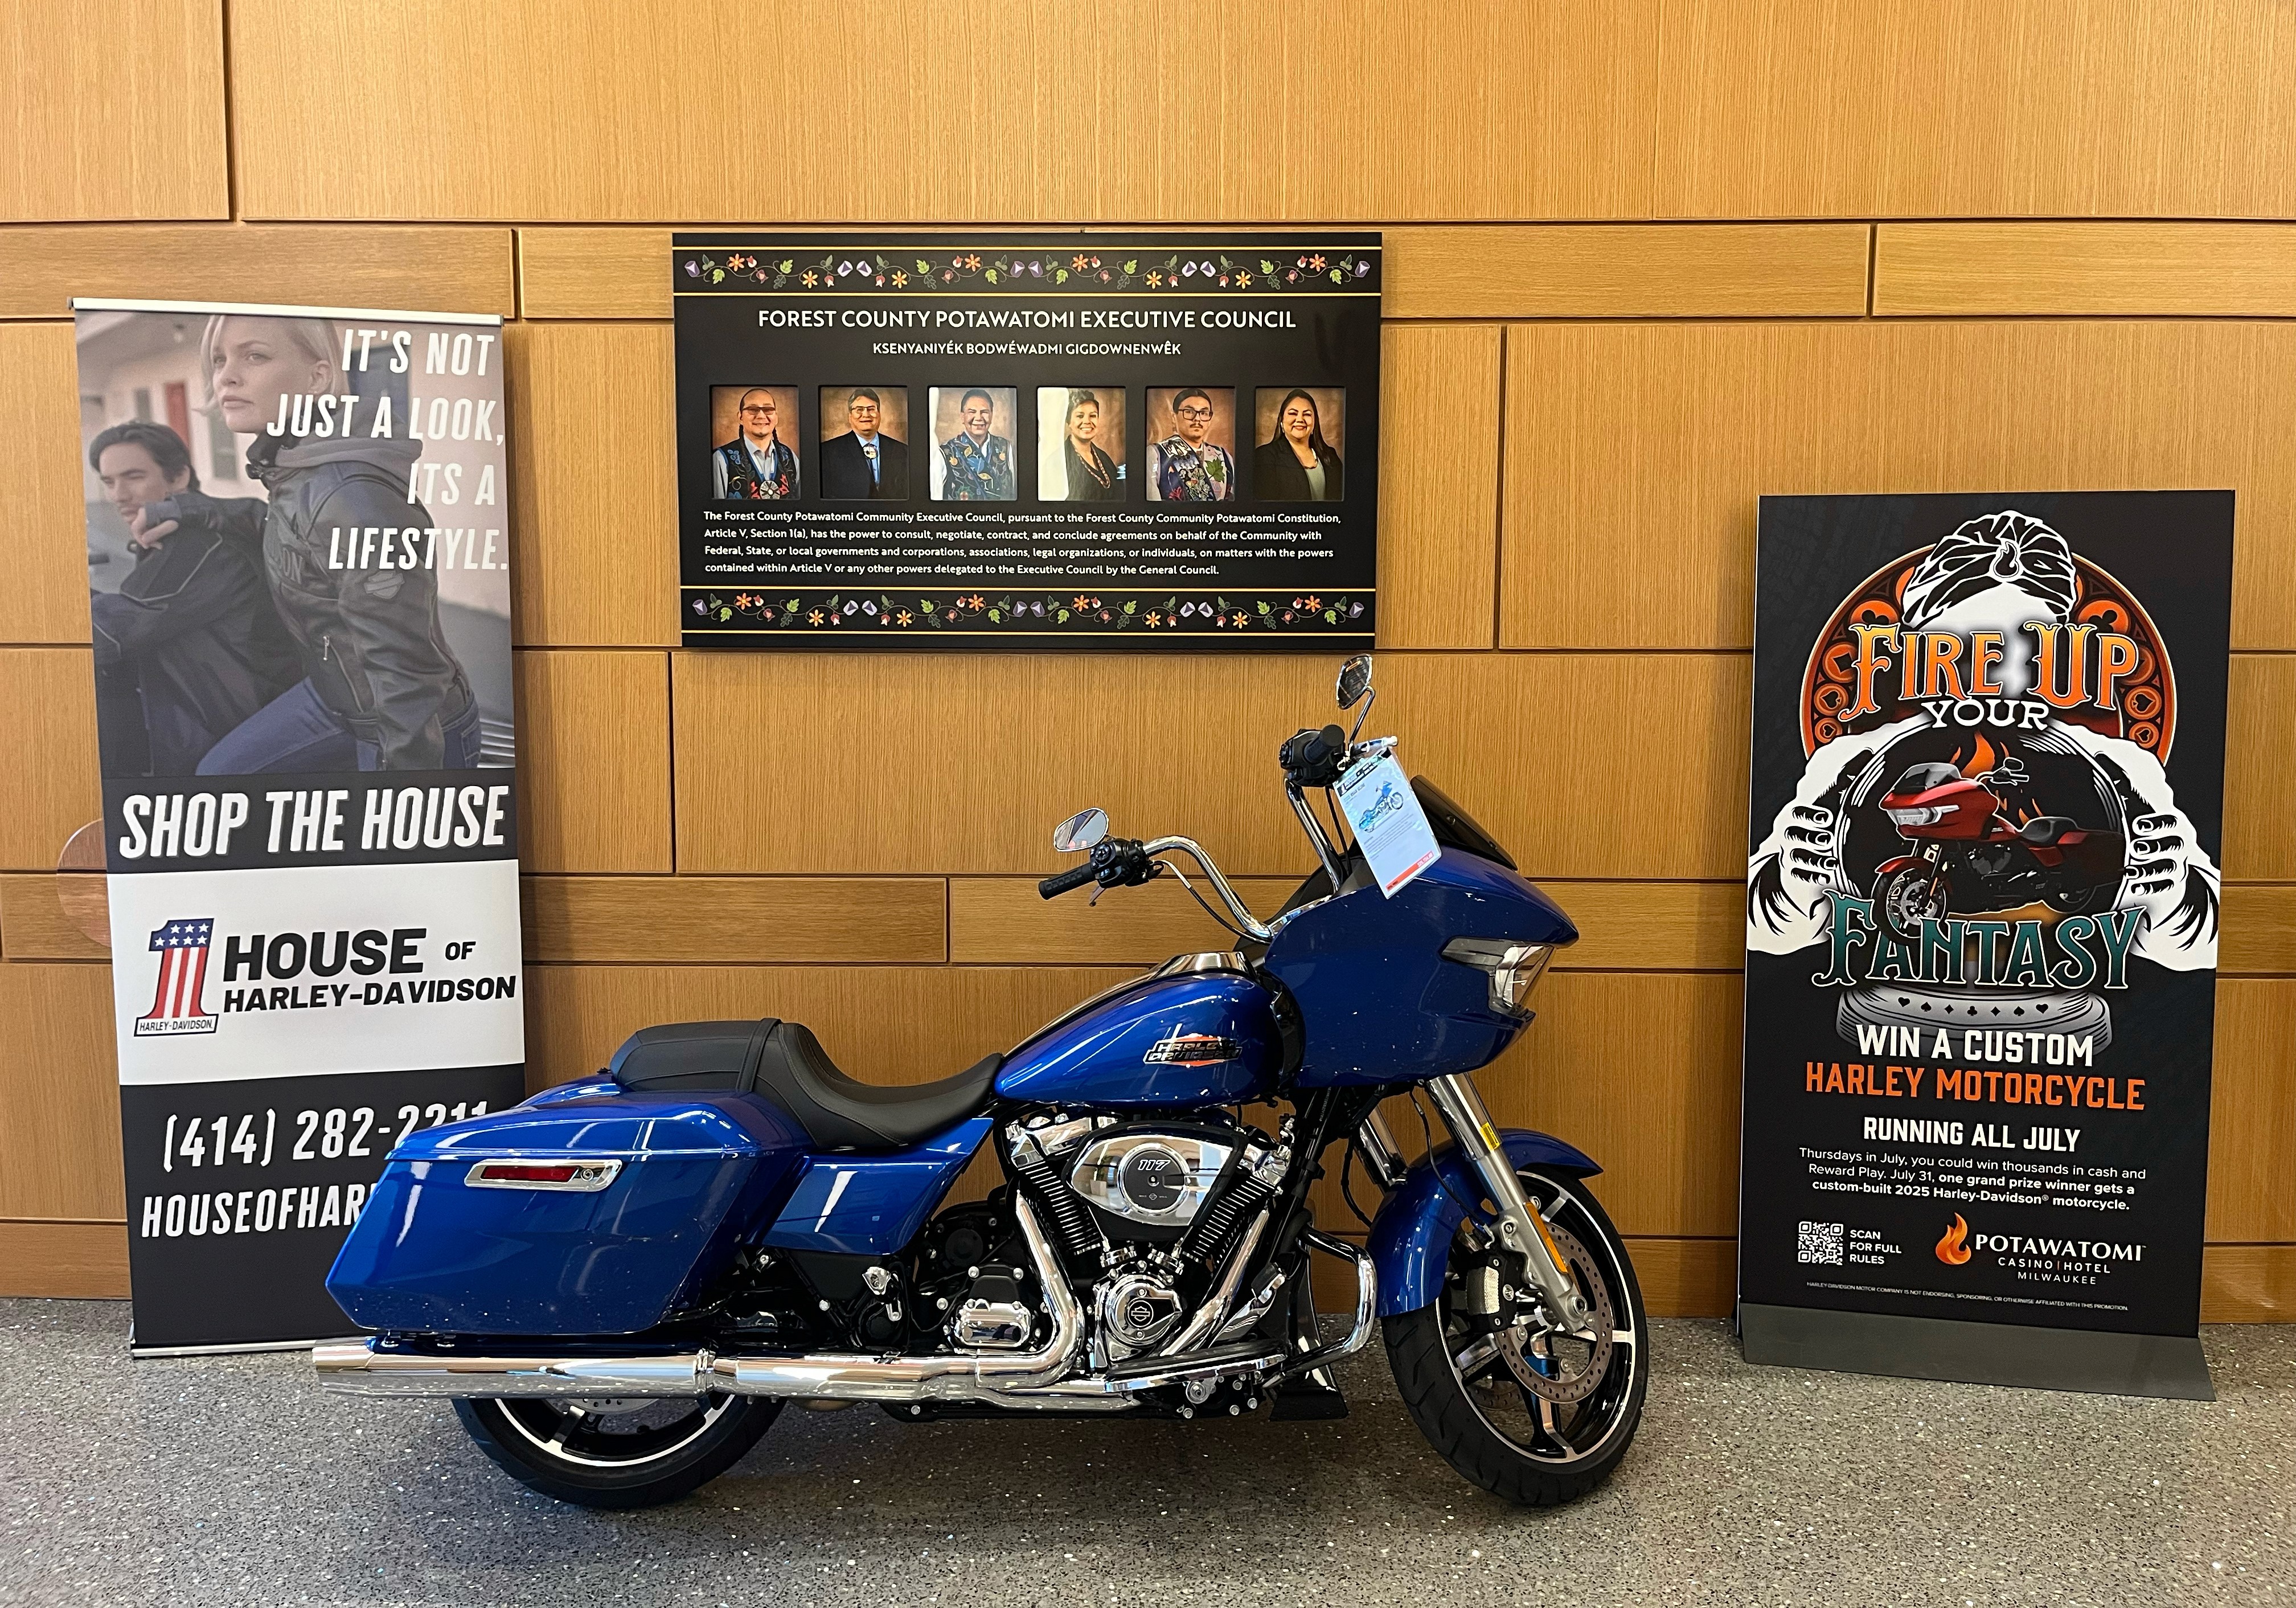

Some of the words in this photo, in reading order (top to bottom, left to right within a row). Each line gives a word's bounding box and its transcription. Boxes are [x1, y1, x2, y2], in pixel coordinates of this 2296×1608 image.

[759, 310, 837, 327] FOREST
[841, 310, 931, 328] COUNTY
[936, 310, 1074, 328] POTAWATOMI
[1081, 310, 1195, 328] EXECUTIVE
[1200, 310, 1296, 328] COUNCIL
[342, 329, 411, 374] IT'S
[426, 333, 495, 377] NOT
[873, 339, 964, 354] KSENYANIYÉK
[966, 340, 1062, 354] BODWÉWADMI
[1065, 340, 1181, 355] GIGDOWNENWÊK
[266, 394, 359, 438] JUST
[371, 396, 392, 439] A
[409, 398, 504, 445] LOOK,
[407, 463, 461, 505] ITS
[474, 464, 495, 506] A
[703, 511, 722, 521] The
[724, 511, 755, 521] Forest
[757, 511, 793, 523] County
[795, 512, 854, 521] Potawatomi
[856, 512, 915, 523] Community
[916, 512, 964, 522] Executive
[965, 512, 1006, 523] Council,
[1008, 513, 1052, 524] pursuant
[1054, 514, 1065, 522] to
[1067, 513, 1084, 522] the
[1086, 513, 1117, 523] Forest
[1118, 513, 1154, 525] County
[1156, 513, 1215, 525] Community
[1216, 513, 1275, 523] Potawatomi
[1277, 513, 1341, 524] Constitution,
[329, 527, 508, 570] LIFESTYLE.
[704, 529, 737, 538] Article
[739, 528, 748, 539] V,
[750, 528, 787, 538] Section
[789, 528, 808, 539] 1(a),
[811, 529, 827, 538] has
[830, 529, 846, 538] the
[848, 531, 880, 541] power
[882, 530, 893, 539] to
[895, 530, 933, 541] consult,
[936, 530, 985, 541] negotiate,
[986, 530, 1030, 541] contract,
[1032, 530, 1051, 539] and
[1053, 530, 1098, 540] conclude
[1100, 531, 1158, 542] agreements
[1175, 530, 1207, 540] behalf
[1208, 530, 1220, 540] of
[1221, 531, 1238, 540] the
[1240, 530, 1298, 542] Community
[1299, 531, 1322, 540] with
[705, 545, 744, 557] Federal,
[746, 546, 774, 557] State,
[789, 546, 813, 555] local
[815, 547, 879, 558] governments
[881, 547, 900, 556] and
[902, 547, 967, 558] corporations,
[969, 547, 1030, 558] associations,
[1033, 547, 1057, 559] legal
[1059, 548, 1126, 559] organizations,
[1142, 548, 1197, 559] individuals,
[1254, 548, 1277, 557] with
[1279, 548, 1295, 557] the
[1298, 550, 1334, 559] powers
[705, 563, 754, 572] contained
[756, 563, 788, 572] within
[789, 563, 823, 572] Article
[824, 563, 833, 572] V
[847, 566, 866, 575] any
[867, 564, 895, 573] other
[896, 566, 932, 575] powers
[934, 564, 983, 575] delegated
[985, 565, 996, 574] to
[998, 564, 1015, 574] the
[1017, 564, 1064, 574] Executive
[1065, 564, 1104, 574] Council
[1106, 565, 1118, 576] by
[1120, 565, 1137, 574] the
[1139, 565, 1178, 574] General
[1179, 565, 1219, 575] Council.
[1838, 623, 2005, 721] FIRE
[2023, 621, 2139, 710] UP
[1921, 698, 2049, 730] YOUR
[119, 792, 251, 859] SHOP
[265, 789, 349, 853] THE
[362, 785, 510, 850] HOUSE
[223, 928, 427, 982] HOUSE
[445, 941, 477, 961] OF
[1811, 889, 2147, 989] FANTASY
[223, 975, 516, 1013] HARLEY-DAVIDSON
[1855, 1024, 1920, 1057] WIN
[1931, 1028, 1953, 1059] A
[1964, 1030, 2093, 1066] CUSTOM
[1806, 1062, 1925, 1098] HARLEY
[1936, 1069, 2146, 1110] MOTORCYCLE
[163, 1108, 276, 1172] (414)
[1864, 1116, 1963, 1145] RUNNING
[1971, 1123, 2016, 1148] ALL
[2023, 1127, 2081, 1152] JULY
[1137, 1159, 1171, 1171] 117
[1799, 1147, 1862, 1163] Thursdays
[1866, 1152, 1876, 1162] in
[1880, 1152, 1908, 1167] July,
[1910, 1157, 1934, 1167] you
[1938, 1157, 1973, 1168] could
[1977, 1159, 1998, 1170] win
[2002, 1160, 2069, 1175] thousands
[2073, 1165, 2084, 1175] in
[2088, 1167, 2118, 1177] cash
[2122, 1169, 2146, 1179] and
[1809, 1163, 1855, 1176] Reward
[1859, 1167, 1887, 1180] Play.
[1890, 1169, 1916, 1183] July
[1918, 1171, 1935, 1183] 31,
[1938, 1174, 1963, 1184] one
[1966, 1176, 2005, 1186] grand
[2009, 1177, 2042, 1189] prize
[2045, 1179, 2091, 1192] winner
[2094, 1184, 2123, 1195] gets
[2126, 1186, 2135, 1194] a
[1812, 1181, 1892, 1194] custom-built
[1895, 1184, 1930, 1197] 2025
[2052, 1197, 2130, 1211] motorcycle.
[1850, 1229, 1881, 1240] SCAN
[1850, 1242, 1872, 1251] FOR
[1875, 1243, 1902, 1254] FULL
[1850, 1254, 1885, 1265] RULES
[1998, 1257, 2053, 1269] CASINO
[2064, 1262, 2111, 1274] HOTEL
[2018, 1271, 2097, 1285] MILWAUKEE
